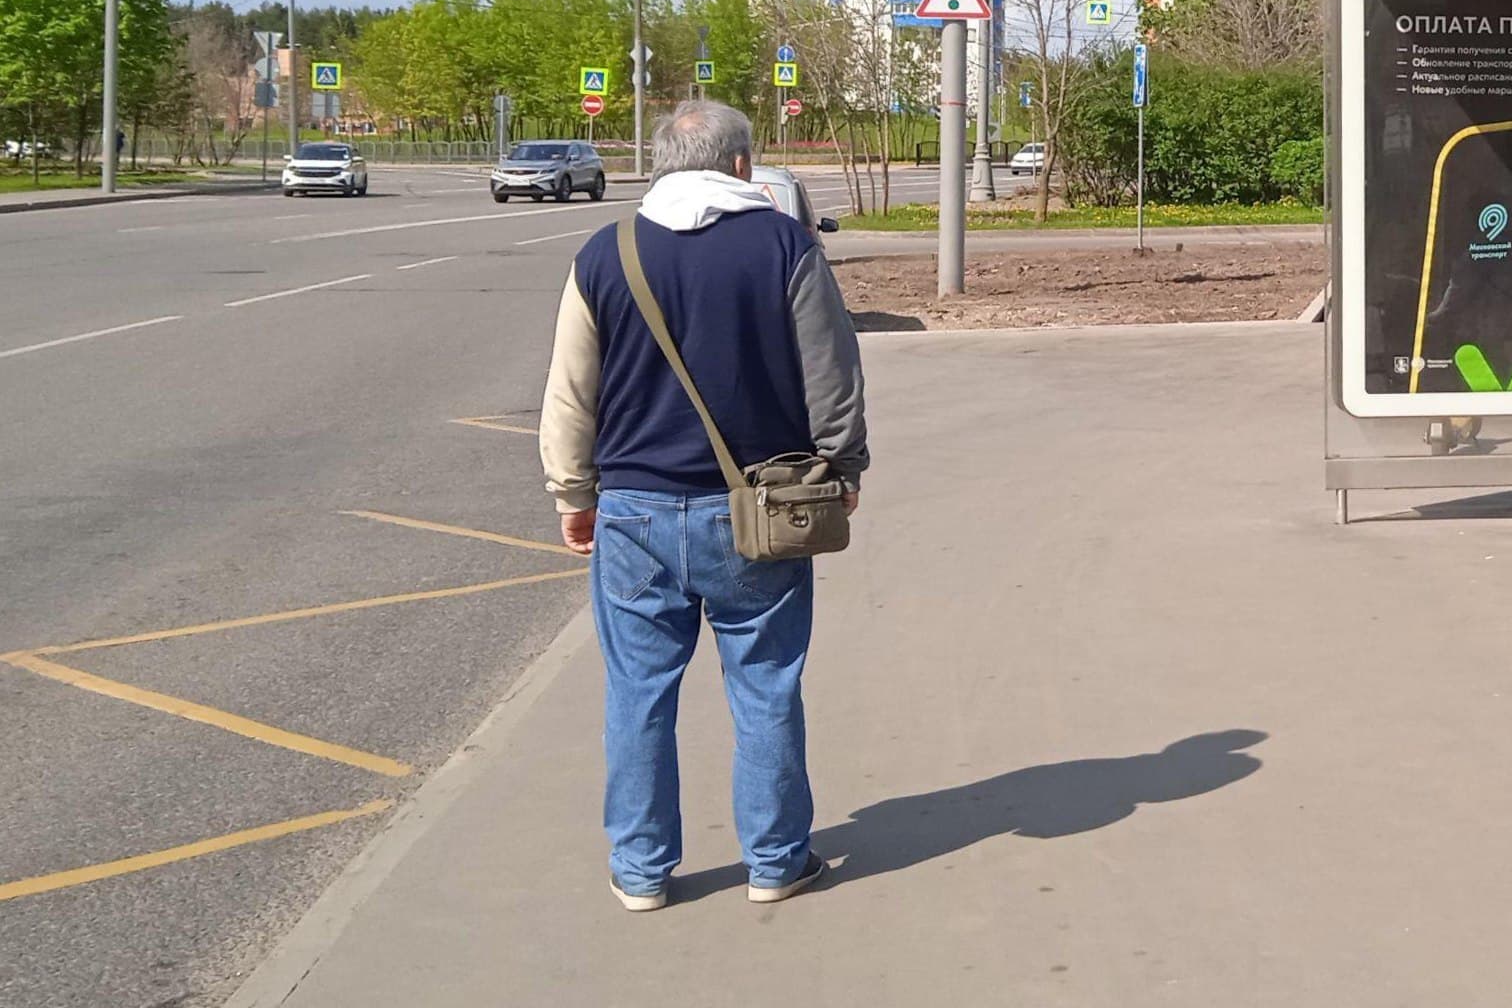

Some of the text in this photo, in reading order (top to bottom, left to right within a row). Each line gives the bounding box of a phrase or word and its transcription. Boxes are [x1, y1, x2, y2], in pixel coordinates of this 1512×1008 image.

[1396, 15, 1493, 34] ОПЛАТА
[1412, 44, 1456, 55] Гарантия
[1457, 46, 1506, 56] получения
[1412, 57, 1470, 67] Обновление
[1412, 71, 1465, 82] Актуальное
[1412, 84, 1443, 94] Новые
[1445, 85, 1485, 96] удобные
